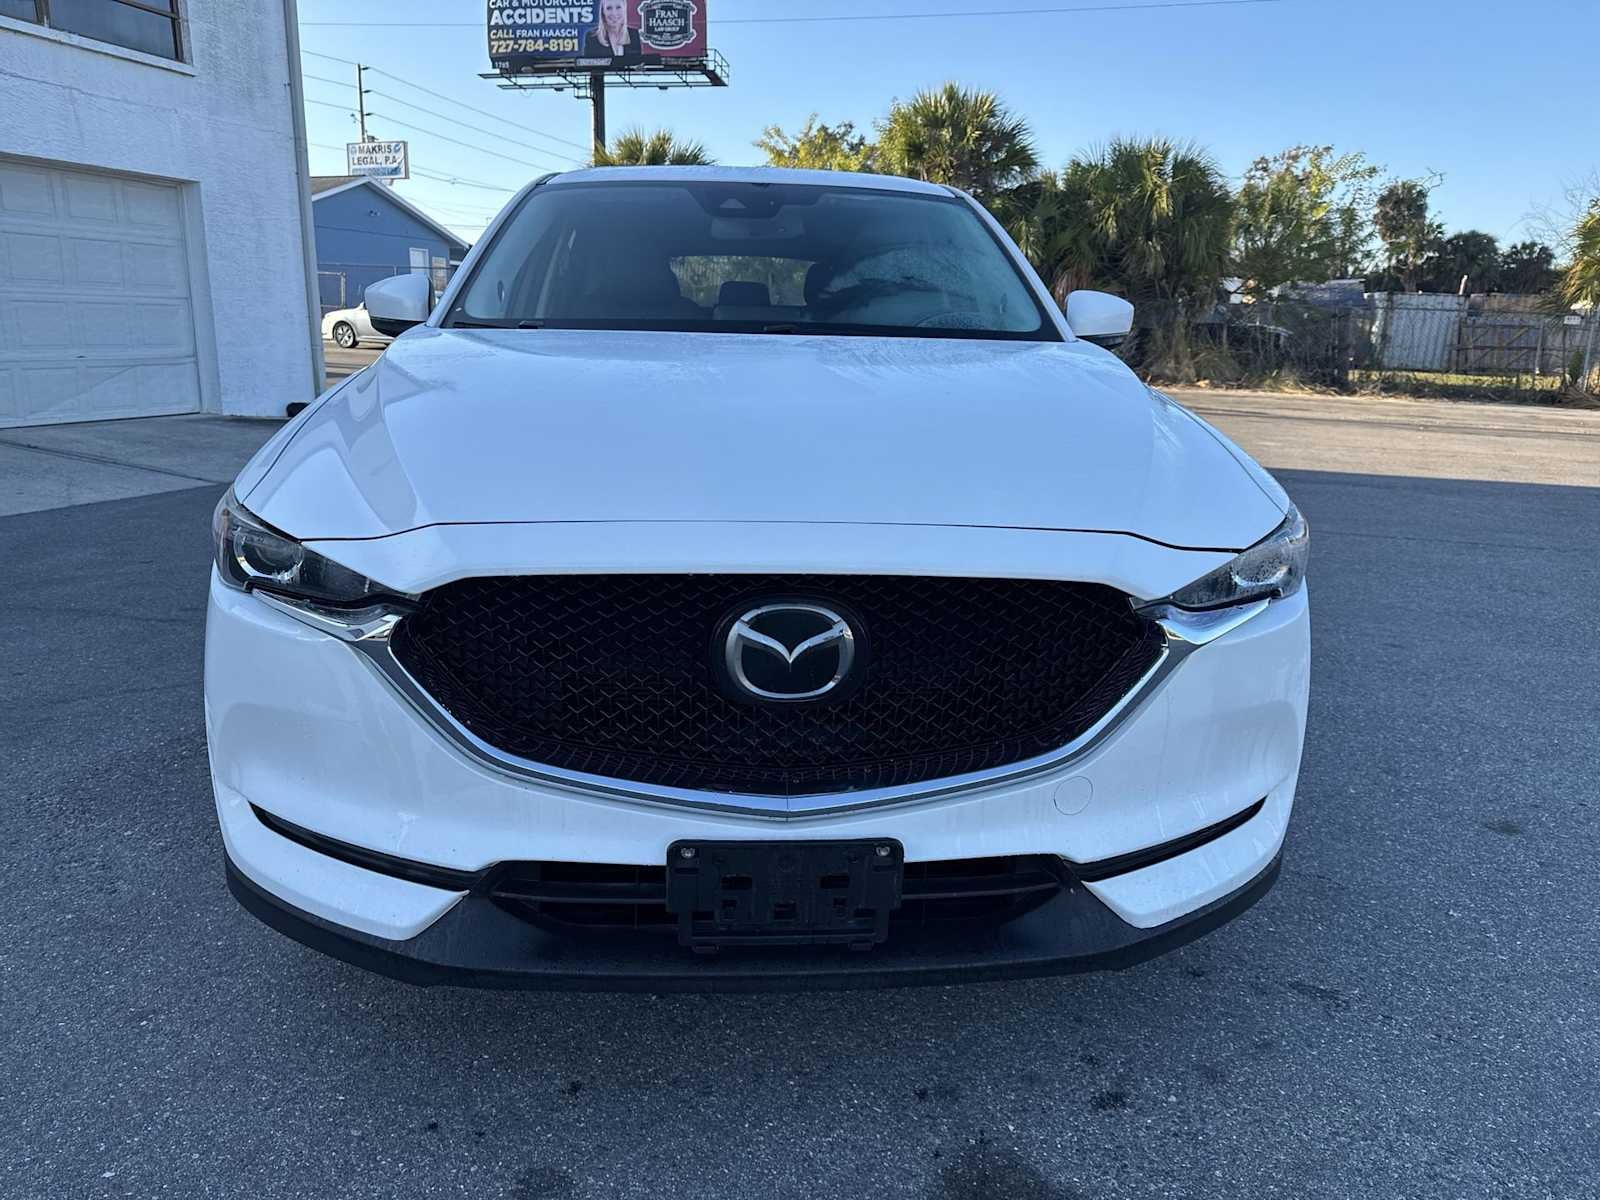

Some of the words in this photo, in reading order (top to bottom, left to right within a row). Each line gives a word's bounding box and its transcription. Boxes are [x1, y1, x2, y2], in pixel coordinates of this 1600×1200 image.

[489, 0, 510, 9] CAR
[490, 7, 594, 25] ACCIDENTS
[655, 9, 679, 18] FRAN
[648, 18, 685, 27] HAASCH
[490, 29, 514, 39] CALL
[516, 29, 540, 38] FRAN
[542, 28, 578, 37] HAASCH
[490, 39, 579, 54] 727-784-8191
[358, 144, 392, 154] MAKRIS
